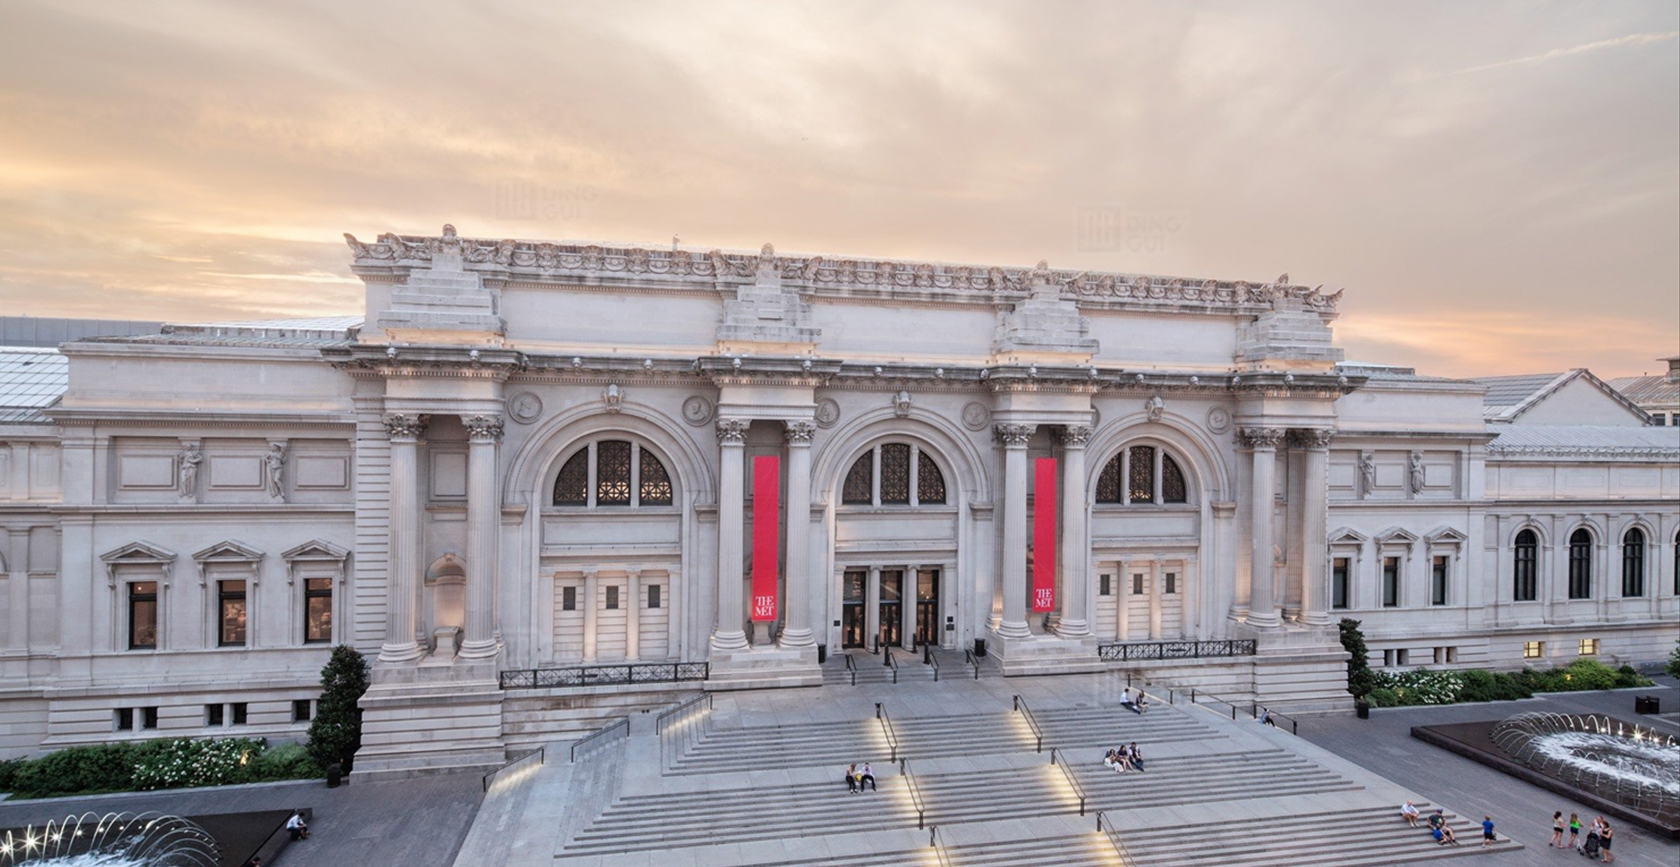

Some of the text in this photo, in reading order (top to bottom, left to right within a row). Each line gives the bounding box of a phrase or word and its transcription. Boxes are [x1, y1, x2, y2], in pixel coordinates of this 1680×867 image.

[1036, 588, 1052, 598] THE
[755, 596, 774, 606] THE
[1036, 597, 1052, 608] MET
[755, 606, 774, 616] MET
